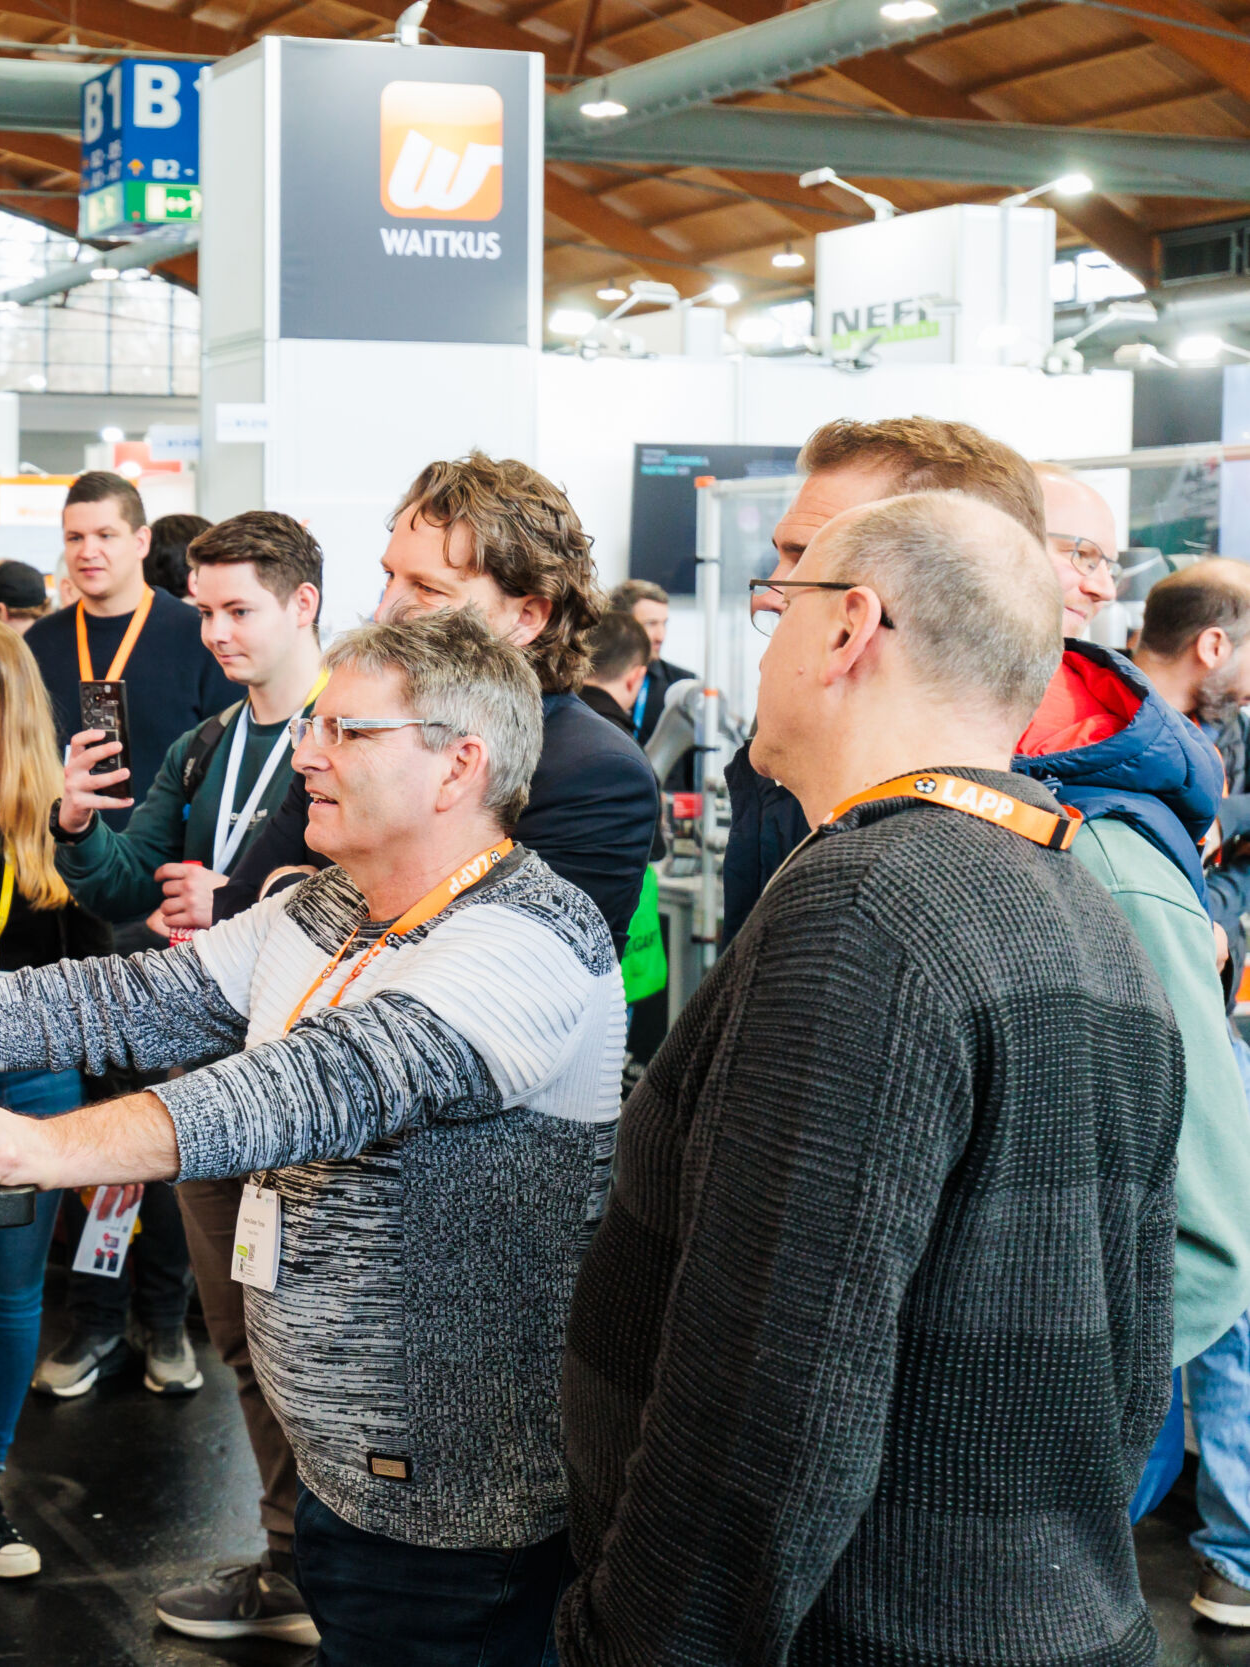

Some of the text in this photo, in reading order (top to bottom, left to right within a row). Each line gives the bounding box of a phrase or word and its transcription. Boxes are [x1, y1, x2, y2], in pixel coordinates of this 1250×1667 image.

[84, 66, 122, 144] B1
[133, 63, 200, 129] B
[379, 228, 502, 260] WAITKUS
[941, 779, 1015, 819] LAPP
[448, 854, 491, 896] LAPP
